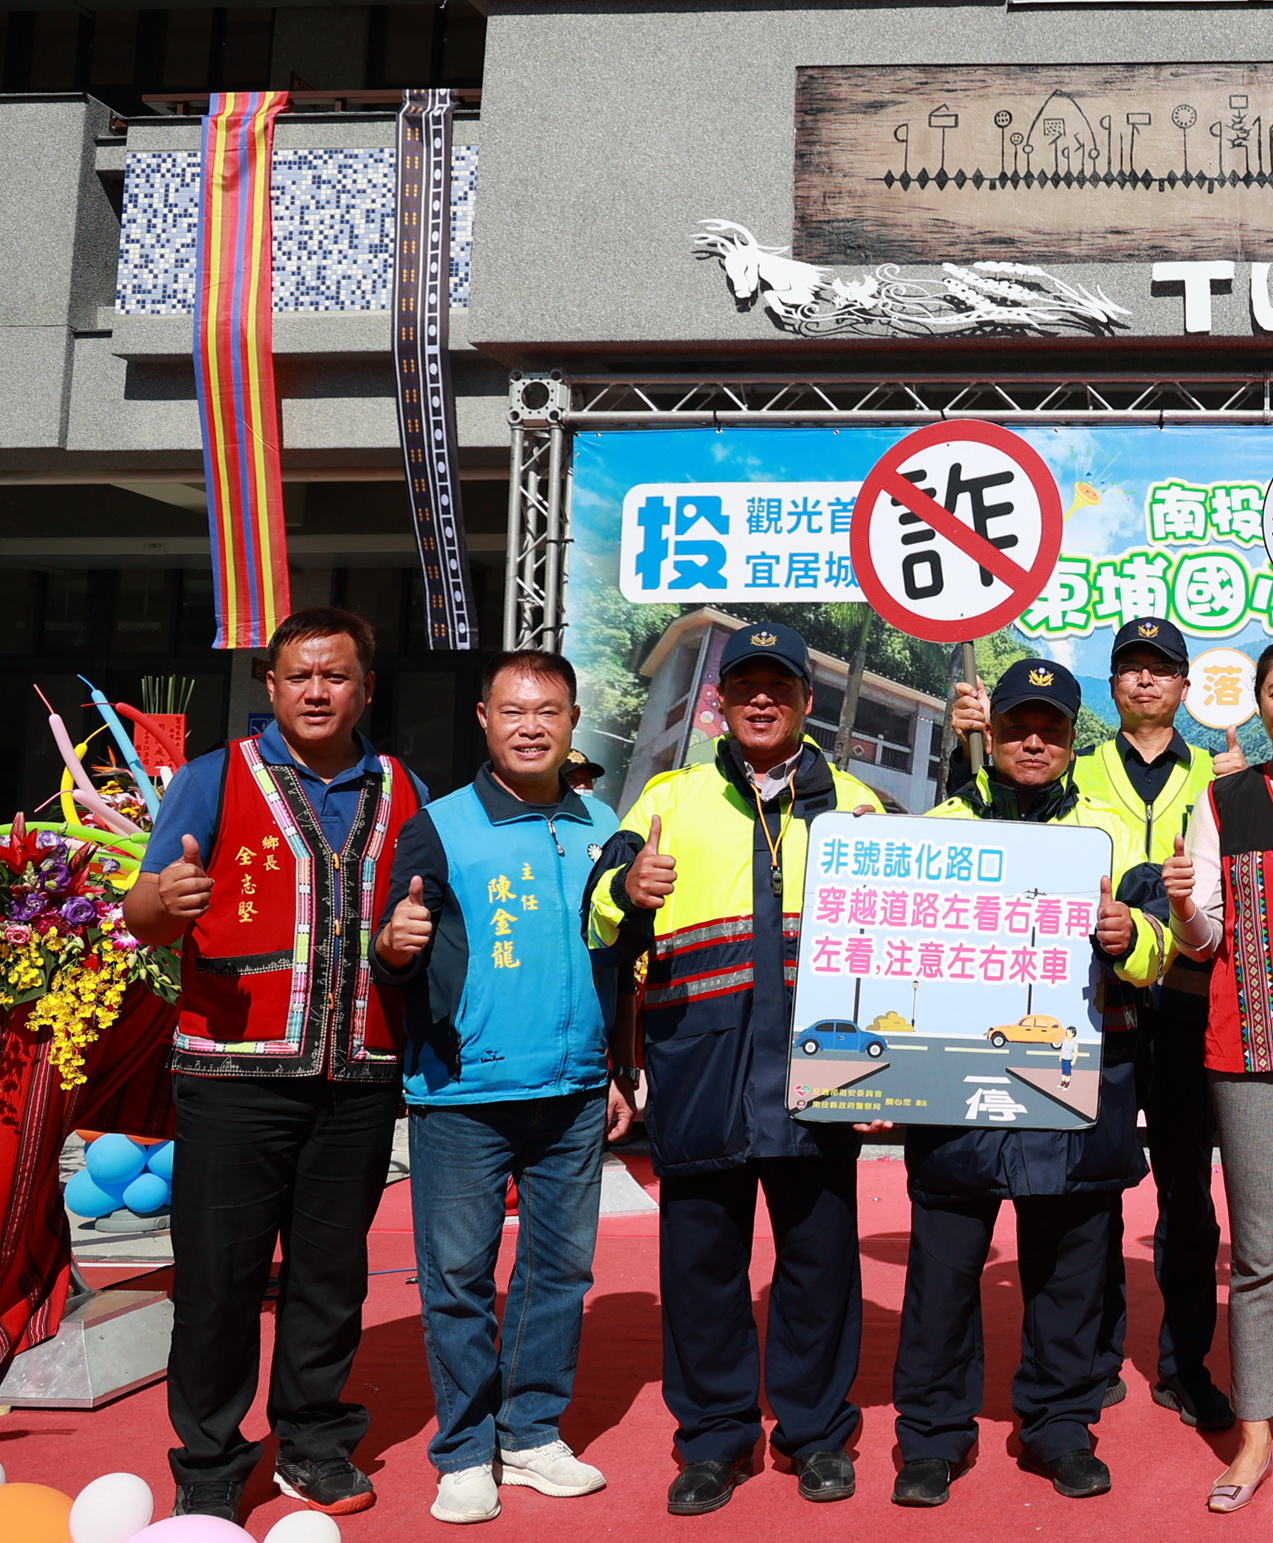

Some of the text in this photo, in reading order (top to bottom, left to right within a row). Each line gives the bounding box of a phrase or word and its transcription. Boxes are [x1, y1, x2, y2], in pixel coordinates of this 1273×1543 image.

[635, 495, 730, 590] 投
[891, 462, 1018, 600] 詐
[235, 846, 259, 923] 全志堅
[262, 835, 281, 871] 鄉長
[820, 838, 1003, 882] 非號誌化路口
[521, 863, 539, 911] 主任
[815, 886, 1093, 938] 穿越道路左看右看再
[487, 874, 522, 969] 陳金龍
